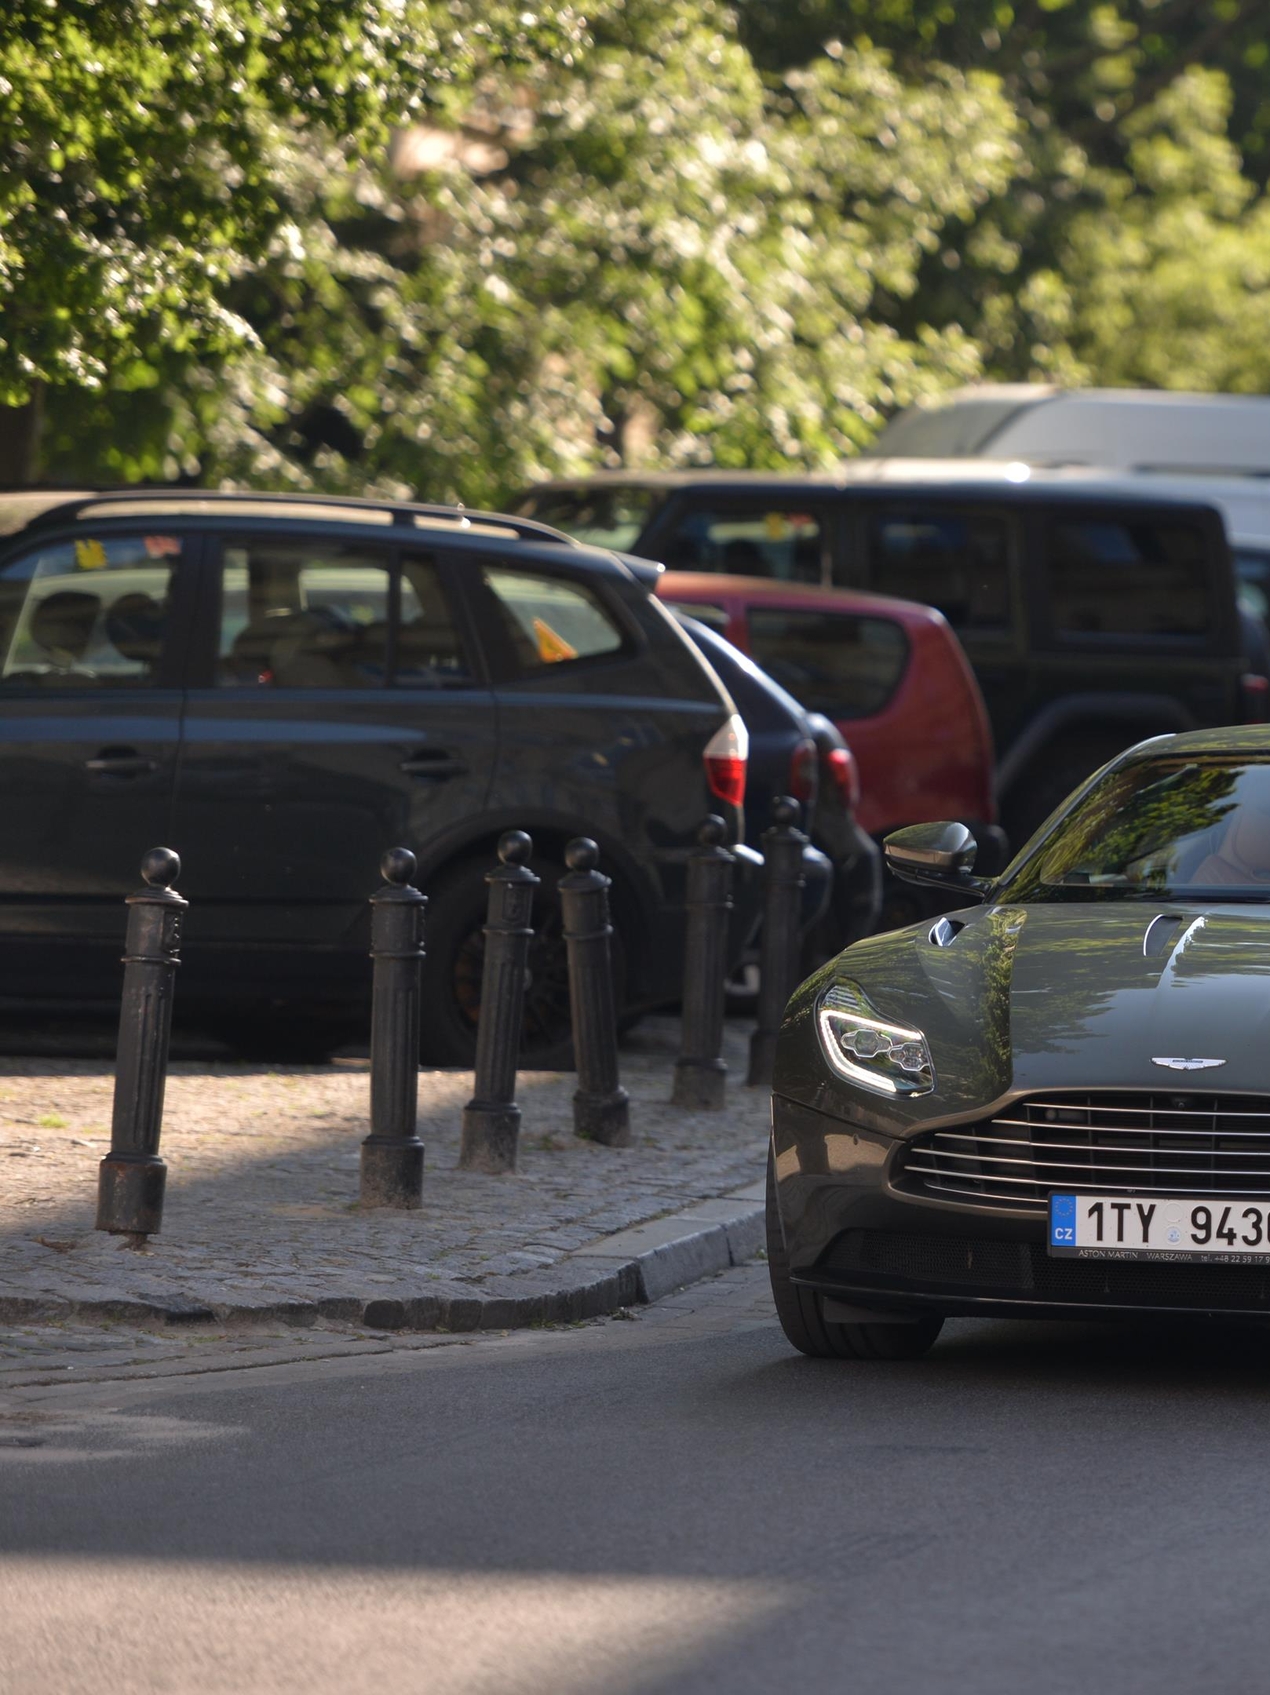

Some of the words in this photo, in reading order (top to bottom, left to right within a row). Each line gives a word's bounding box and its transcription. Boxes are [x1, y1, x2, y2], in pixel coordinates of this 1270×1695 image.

[1088, 1202, 1157, 1243] 1TY
[1055, 1228, 1073, 1240] CZ
[1079, 1249, 1106, 1258] ASTON
[1107, 1250, 1138, 1259] MARTIN
[1146, 1252, 1193, 1261] WARSZAWA
